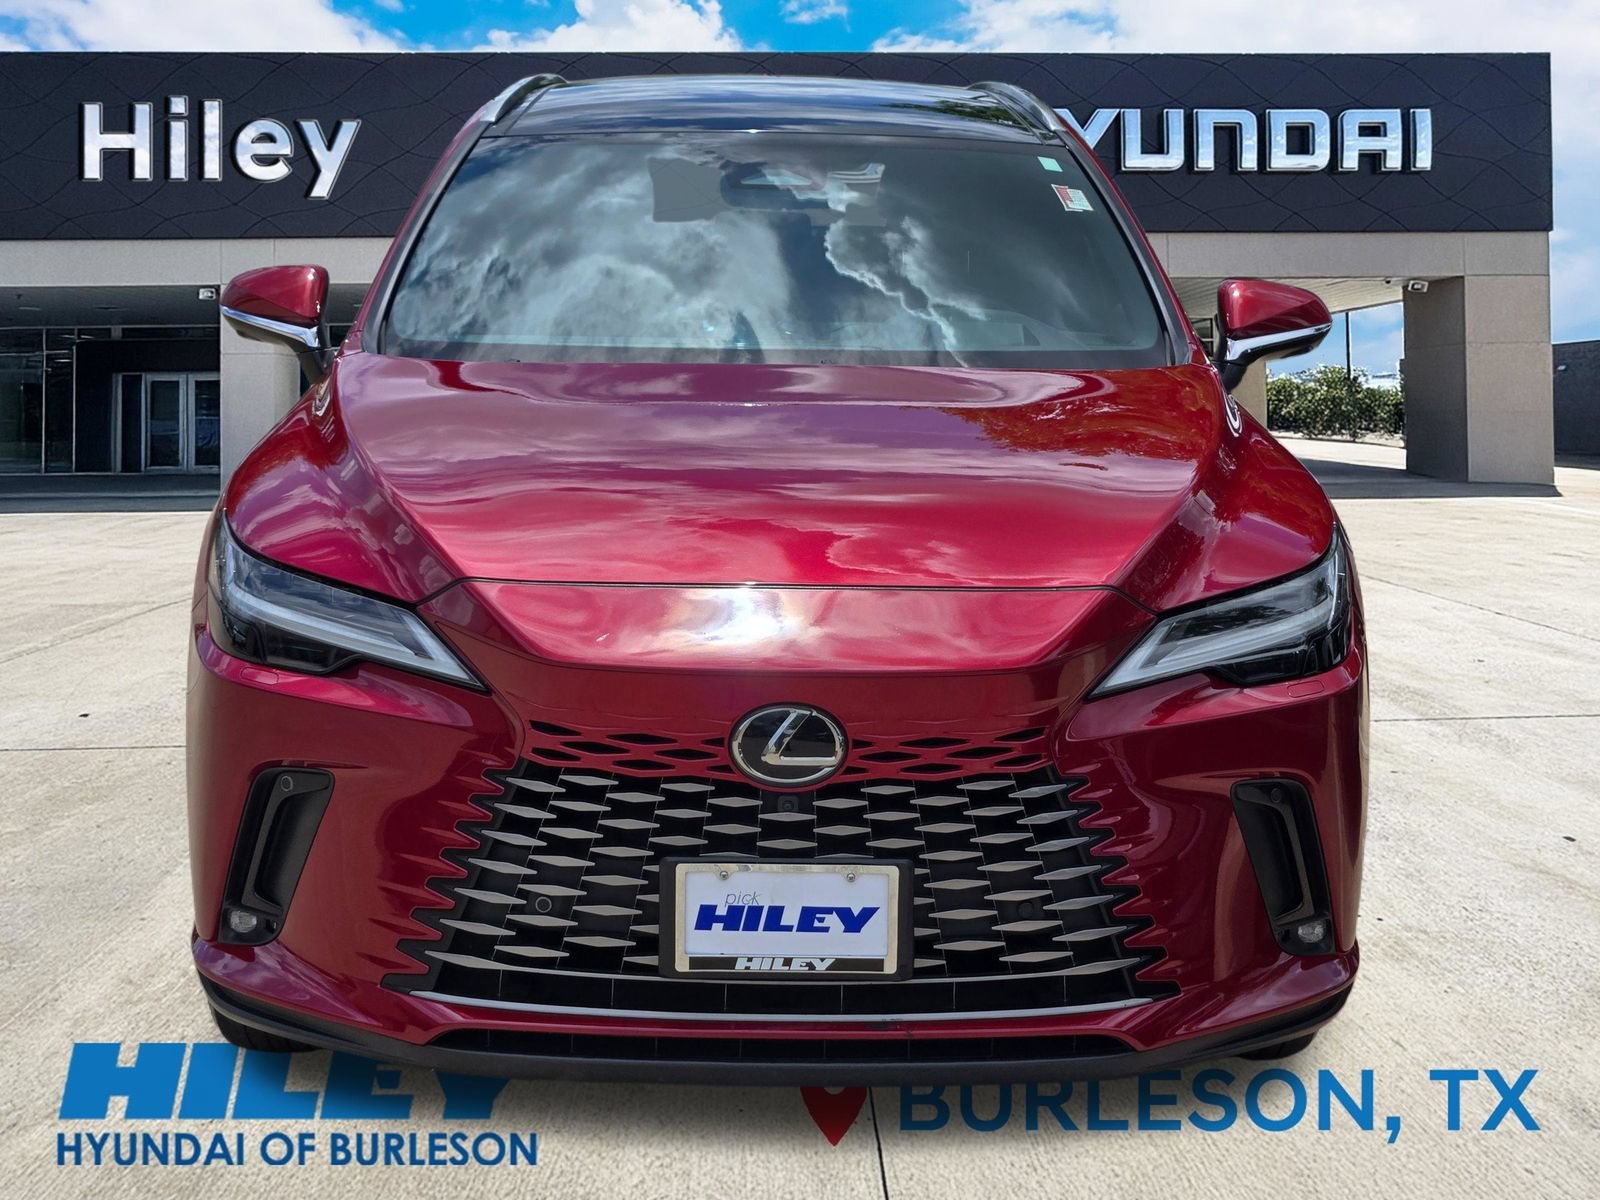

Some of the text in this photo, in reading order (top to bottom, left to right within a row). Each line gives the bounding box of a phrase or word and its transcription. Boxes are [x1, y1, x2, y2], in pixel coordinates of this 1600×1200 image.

[80, 95, 361, 199] Hiley
[694, 904, 880, 933] HILEY
[734, 957, 835, 971] HILEY
